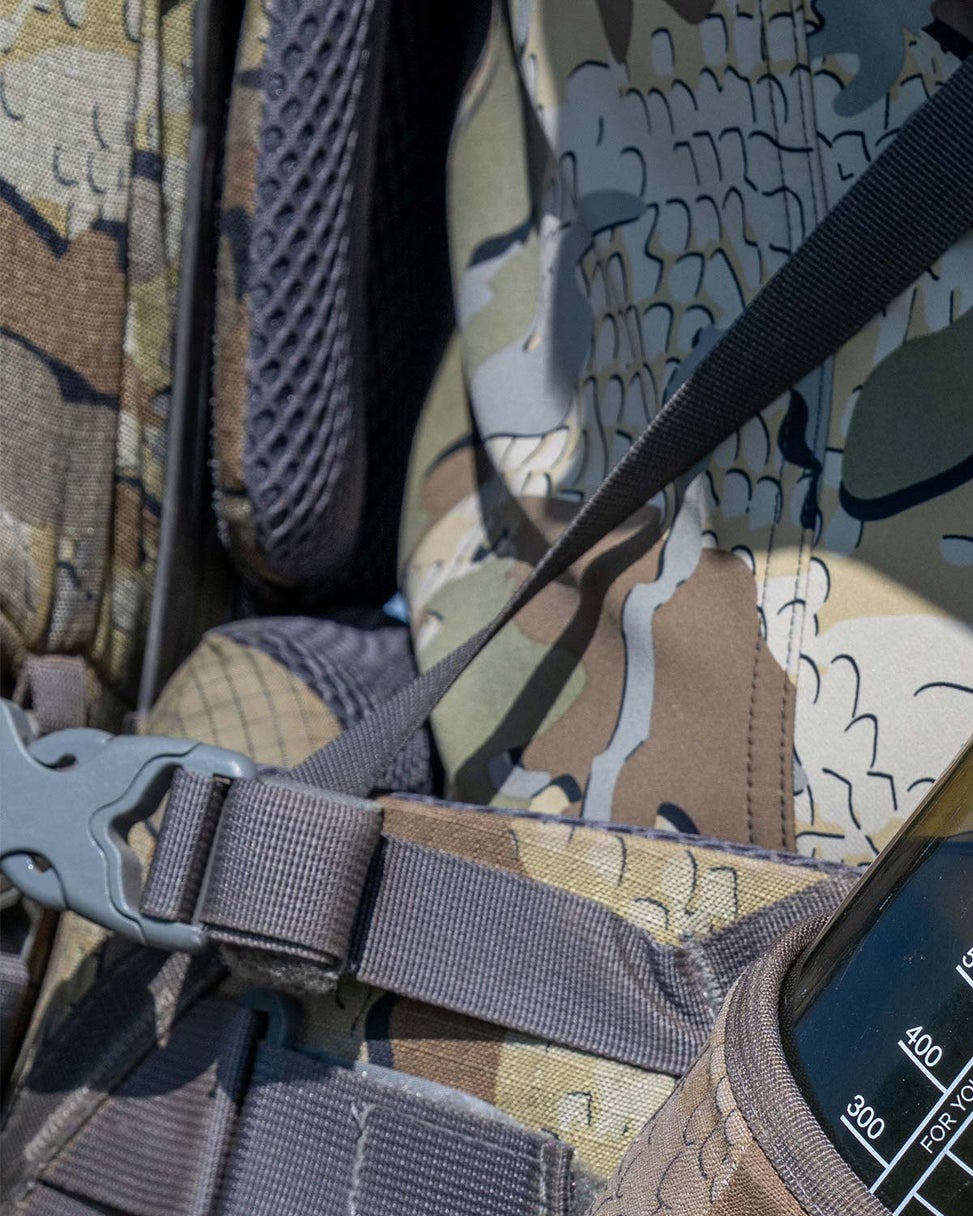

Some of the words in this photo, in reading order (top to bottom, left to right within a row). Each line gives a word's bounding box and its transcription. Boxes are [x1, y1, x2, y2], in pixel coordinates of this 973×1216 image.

[905, 1026, 943, 1067] 400
[847, 1094, 885, 1139] 300
[920, 1112, 957, 1154] FOR
